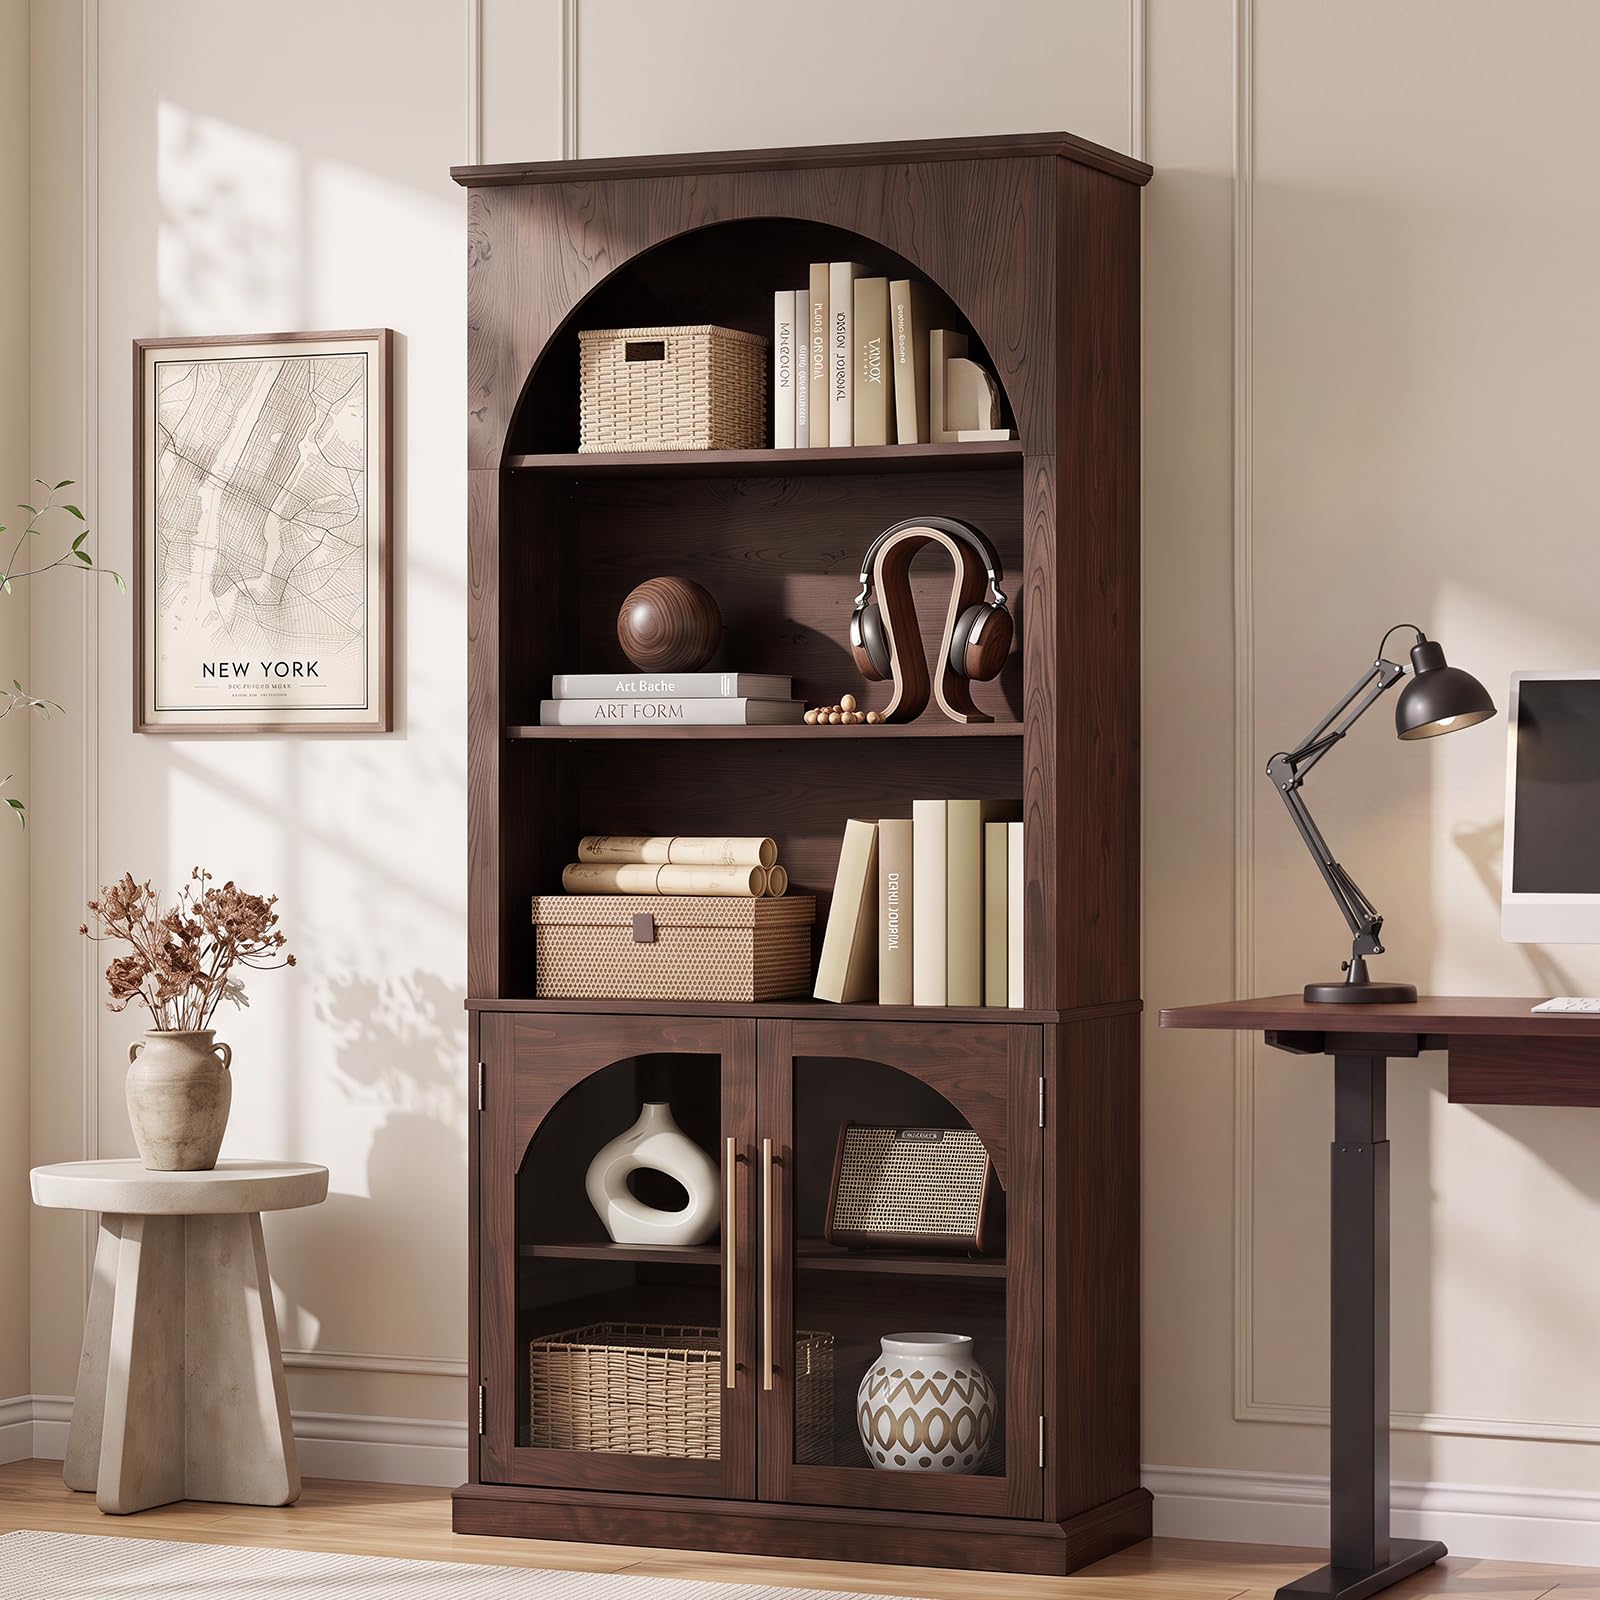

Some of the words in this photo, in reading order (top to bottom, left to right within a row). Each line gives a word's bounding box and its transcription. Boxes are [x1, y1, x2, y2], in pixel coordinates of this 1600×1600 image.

[202, 662, 250, 678] NEW
[260, 660, 319, 677] YORK
[615, 681, 636, 692] Art
[639, 680, 675, 692] Bache
[594, 703, 629, 718] ART
[632, 703, 684, 718] FORM
